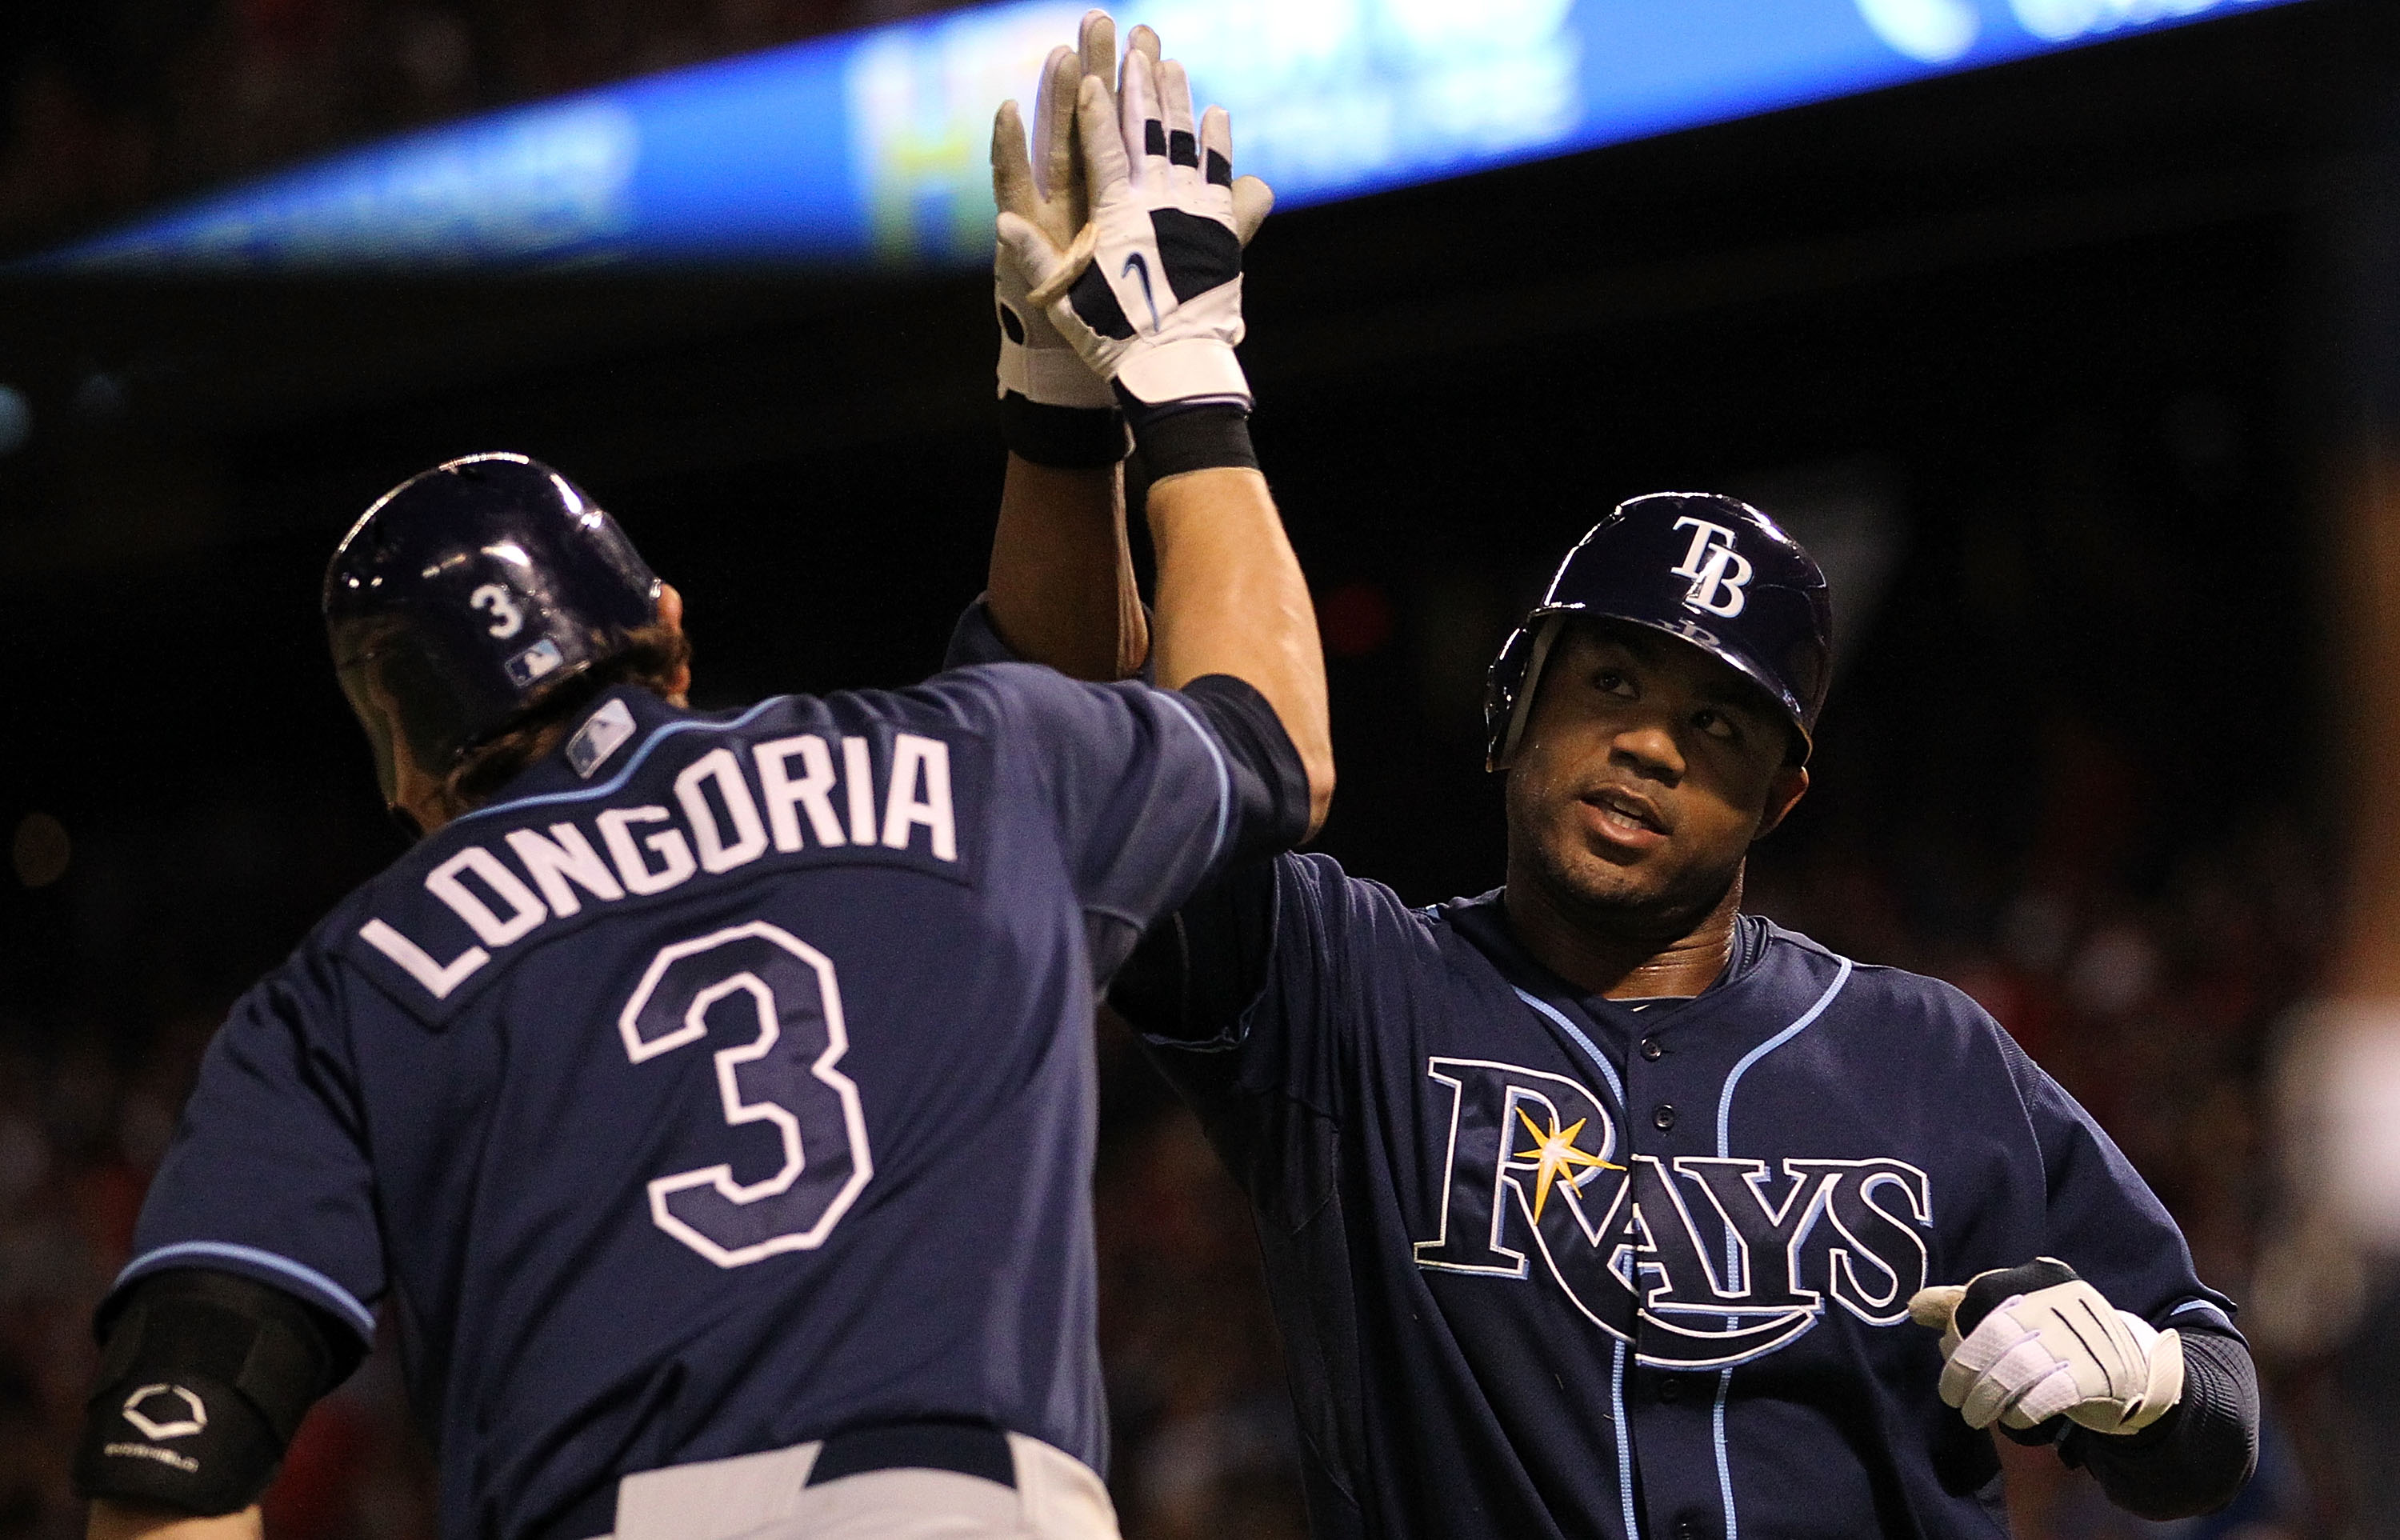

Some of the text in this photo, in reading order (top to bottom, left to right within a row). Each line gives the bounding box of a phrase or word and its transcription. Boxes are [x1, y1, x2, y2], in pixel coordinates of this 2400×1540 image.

[470, 584, 523, 639] 3
[1670, 516, 1754, 618] TB
[359, 733, 957, 999] LONGORIA
[618, 919, 874, 1269] 3
[1414, 1056, 1933, 1370] RAYS
